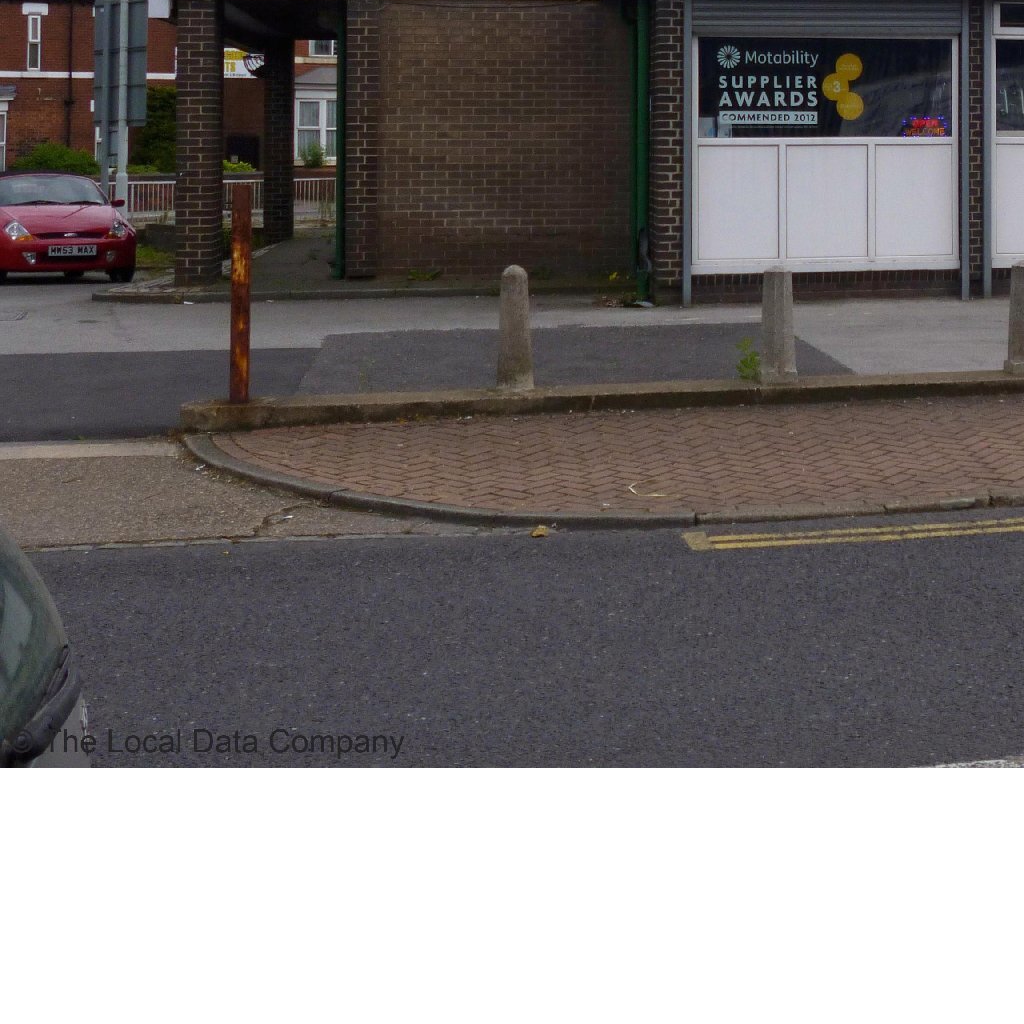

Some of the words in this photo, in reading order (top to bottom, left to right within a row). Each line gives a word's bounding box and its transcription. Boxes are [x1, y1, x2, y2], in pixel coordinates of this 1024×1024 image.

[744, 50, 819, 68] Motability
[718, 75, 818, 89] SUPPLIER
[718, 91, 818, 108] AWARDS
[721, 113, 790, 122] COMMENDED
[794, 113, 816, 122] 2012
